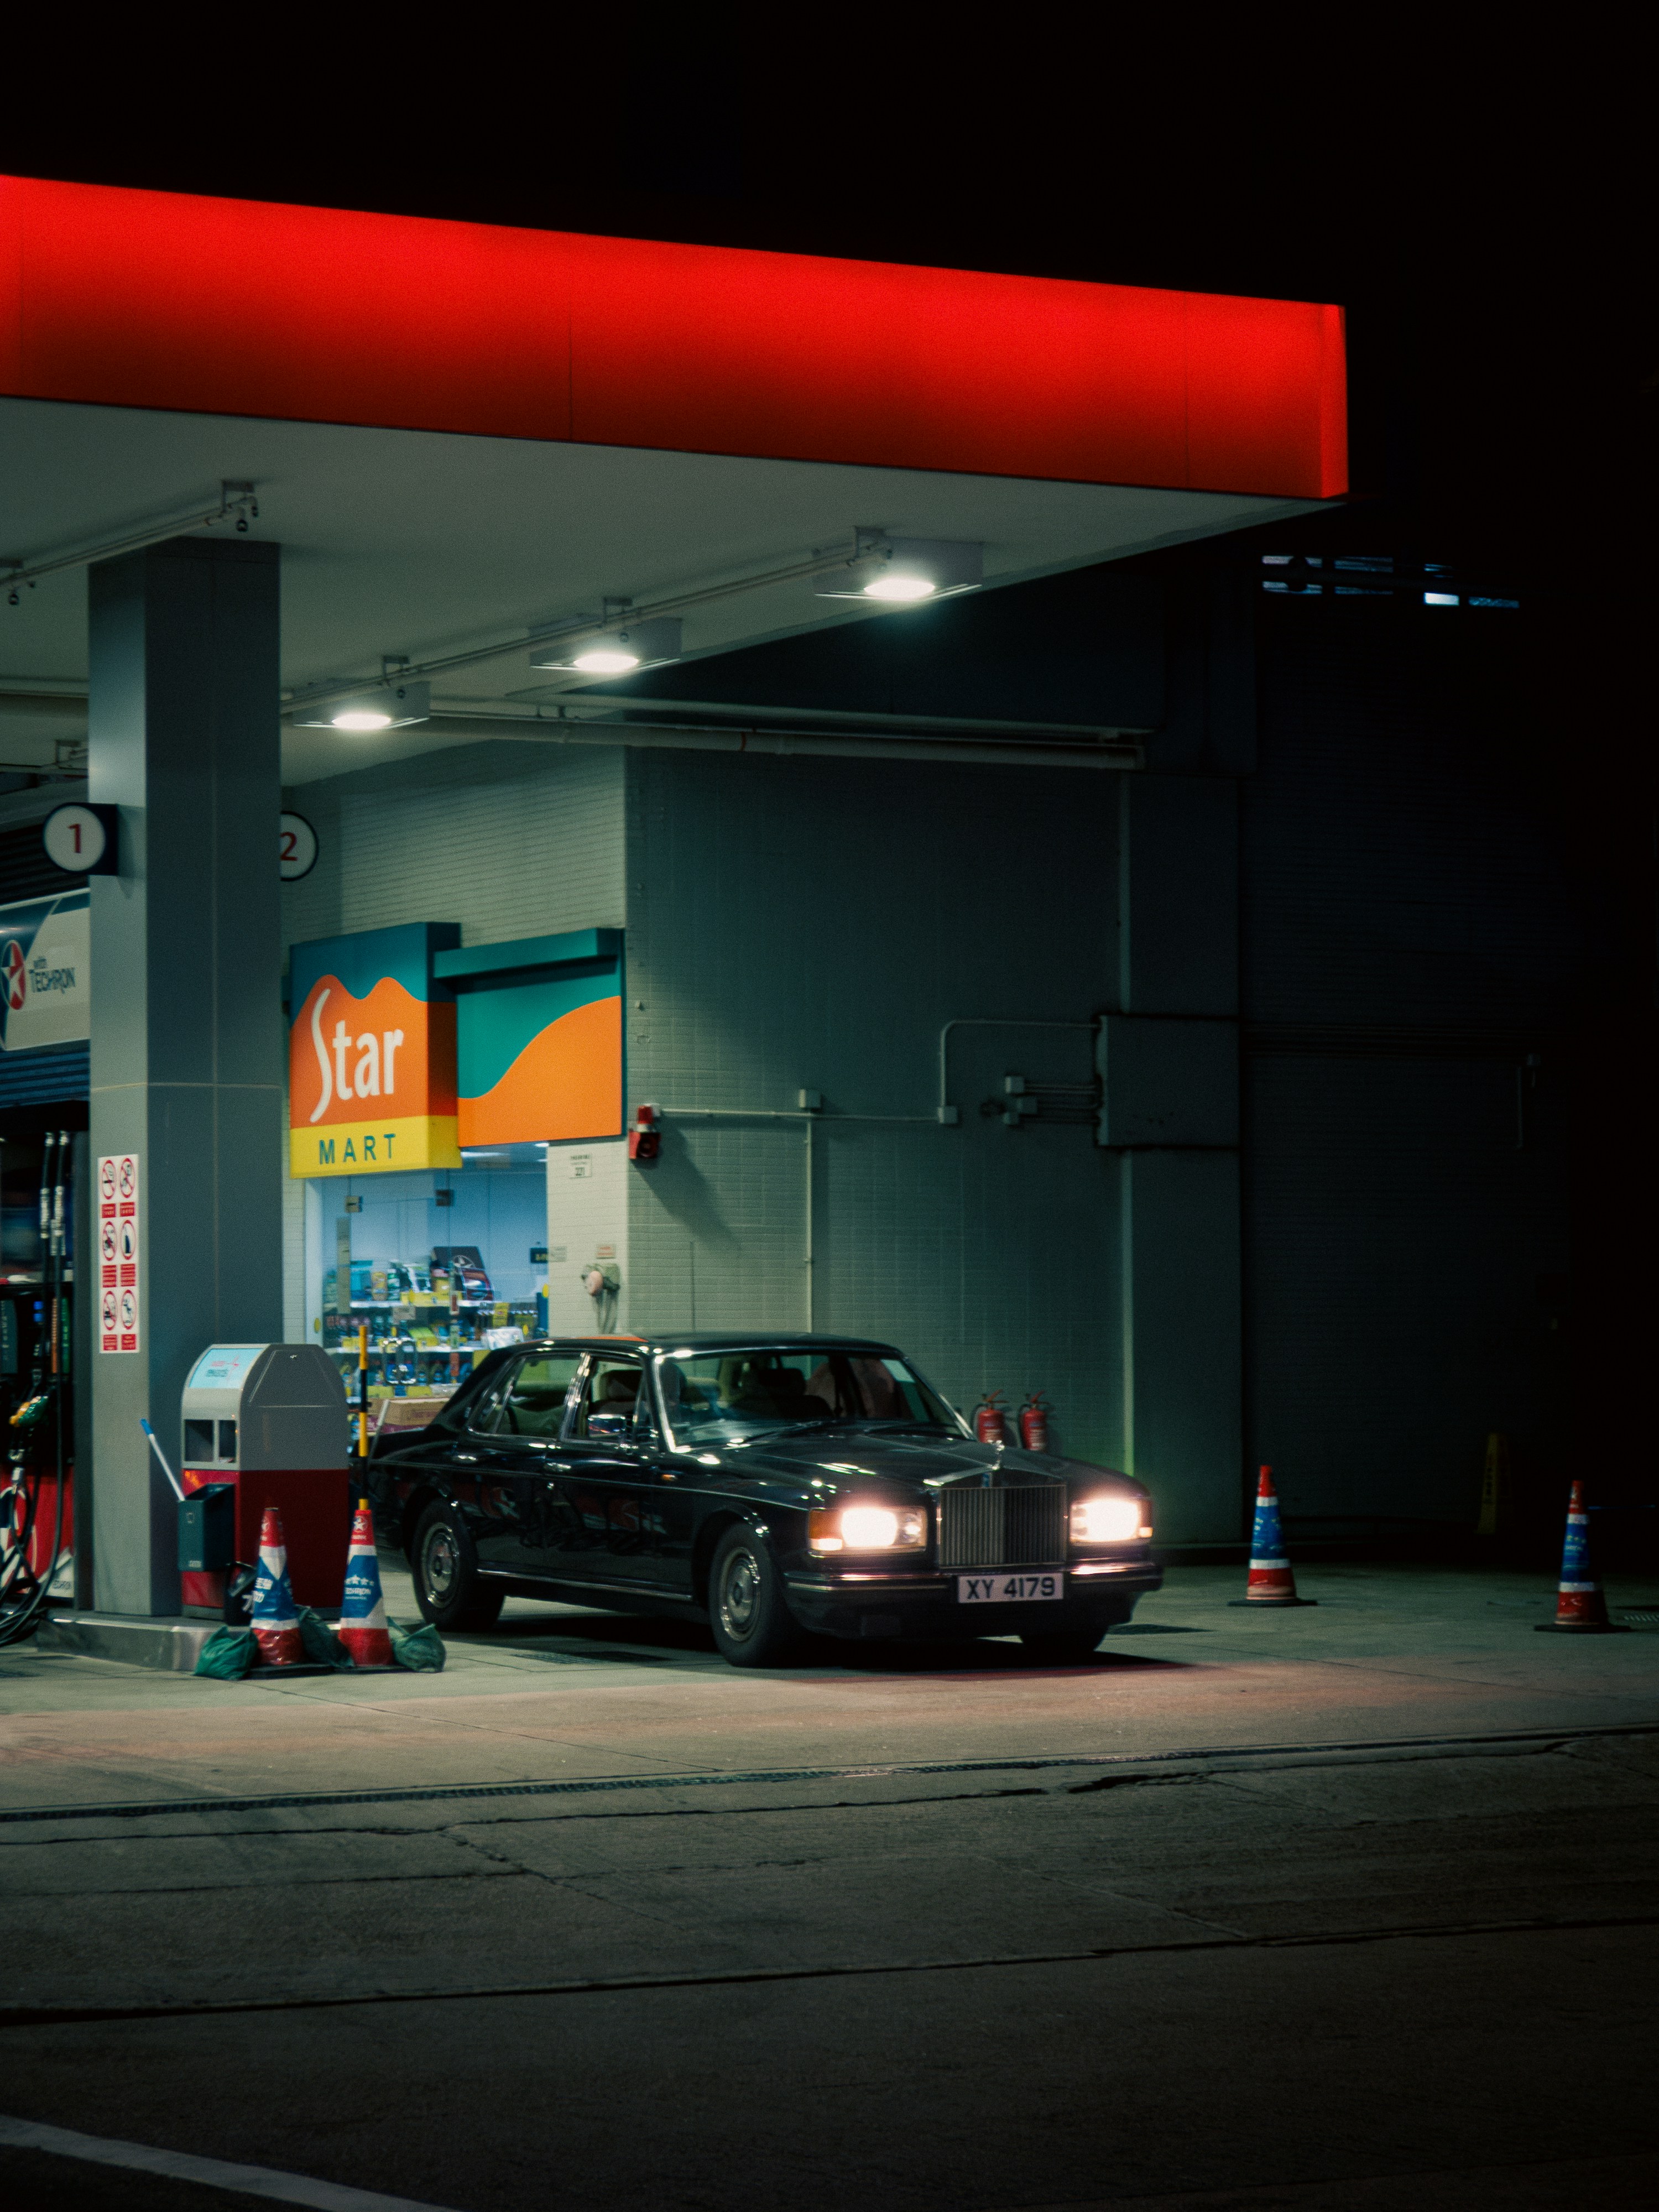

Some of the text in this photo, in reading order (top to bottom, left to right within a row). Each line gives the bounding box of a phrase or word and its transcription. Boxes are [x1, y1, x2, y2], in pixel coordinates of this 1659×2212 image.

[67, 824, 81, 853] 1
[280, 832, 298, 861] 2
[310, 988, 405, 1123] Star
[319, 1133, 396, 1165] MART
[967, 1577, 1055, 1599] XY 4179
